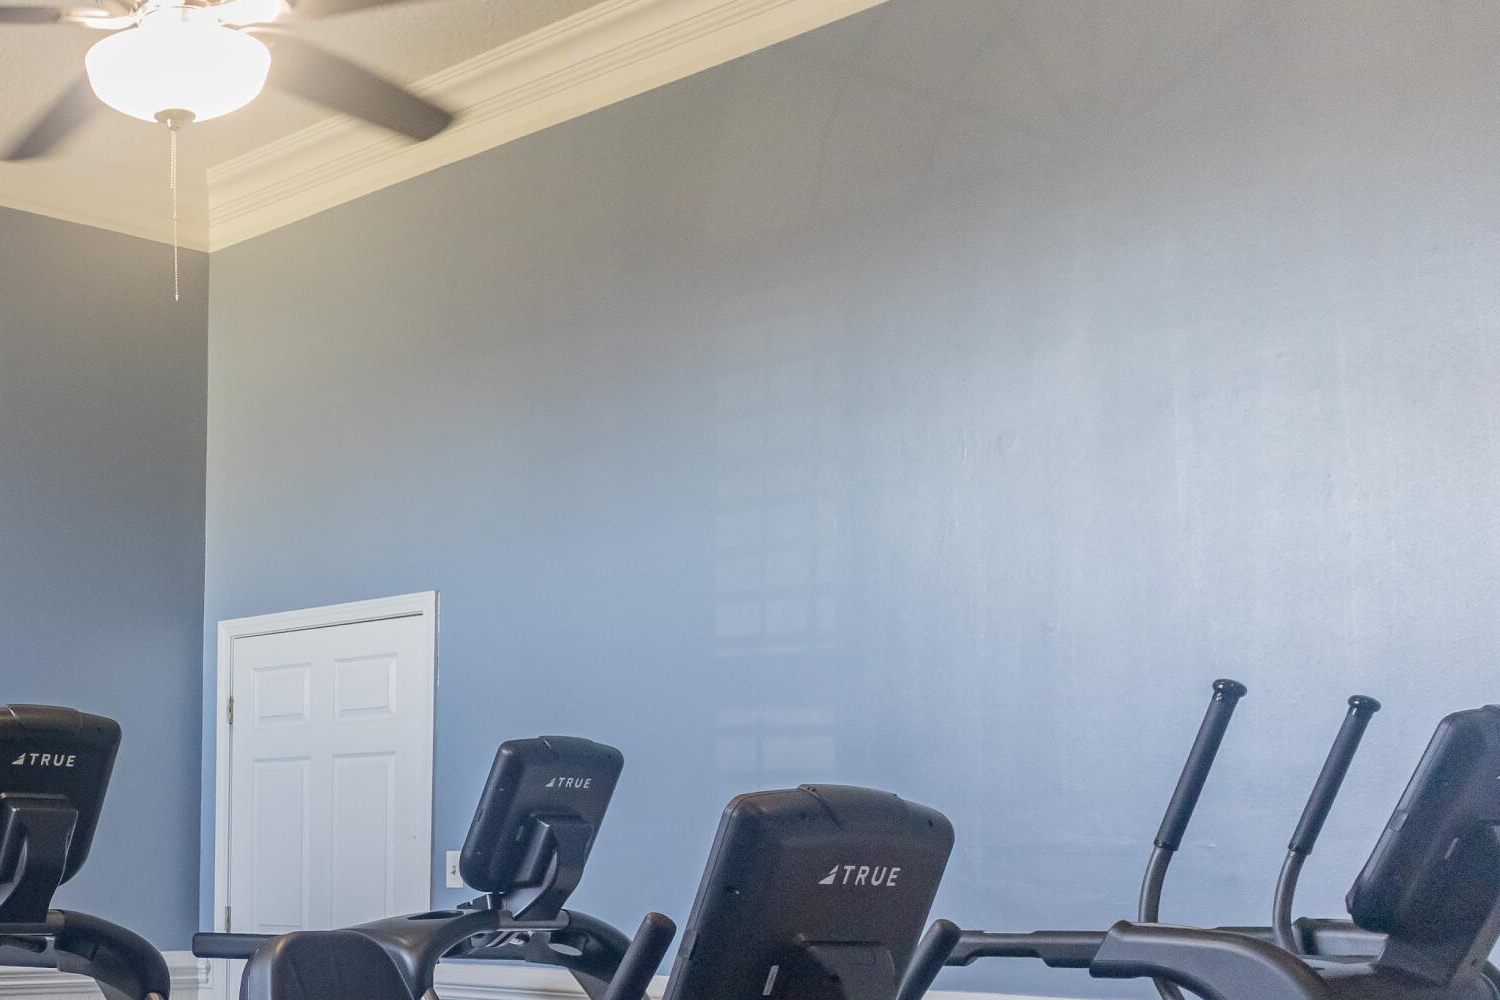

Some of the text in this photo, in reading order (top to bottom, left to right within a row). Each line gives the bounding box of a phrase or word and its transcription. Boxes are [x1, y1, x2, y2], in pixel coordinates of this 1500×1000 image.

[29, 753, 77, 767] TRUE
[558, 777, 592, 789] TRUE
[842, 865, 901, 886] TRUE
